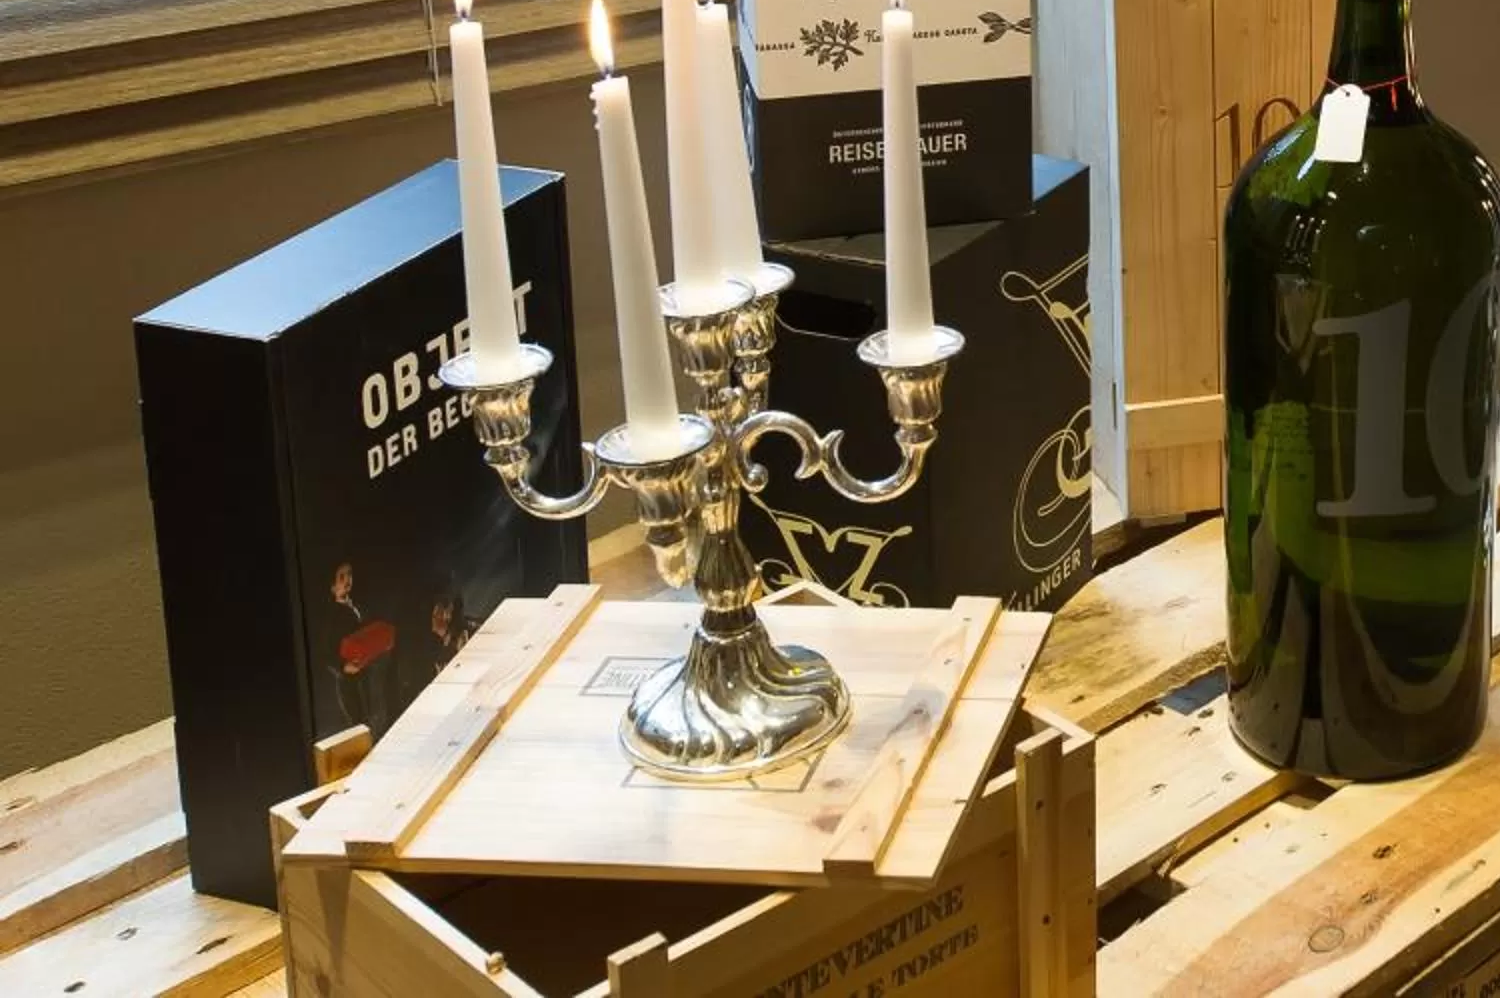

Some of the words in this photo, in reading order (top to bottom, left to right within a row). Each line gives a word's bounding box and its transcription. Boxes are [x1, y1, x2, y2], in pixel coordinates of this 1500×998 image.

[829, 133, 967, 164] REISEAUER
[362, 281, 532, 429] OBJET
[367, 423, 419, 480] DER
[891, 923, 980, 987] TORTE
